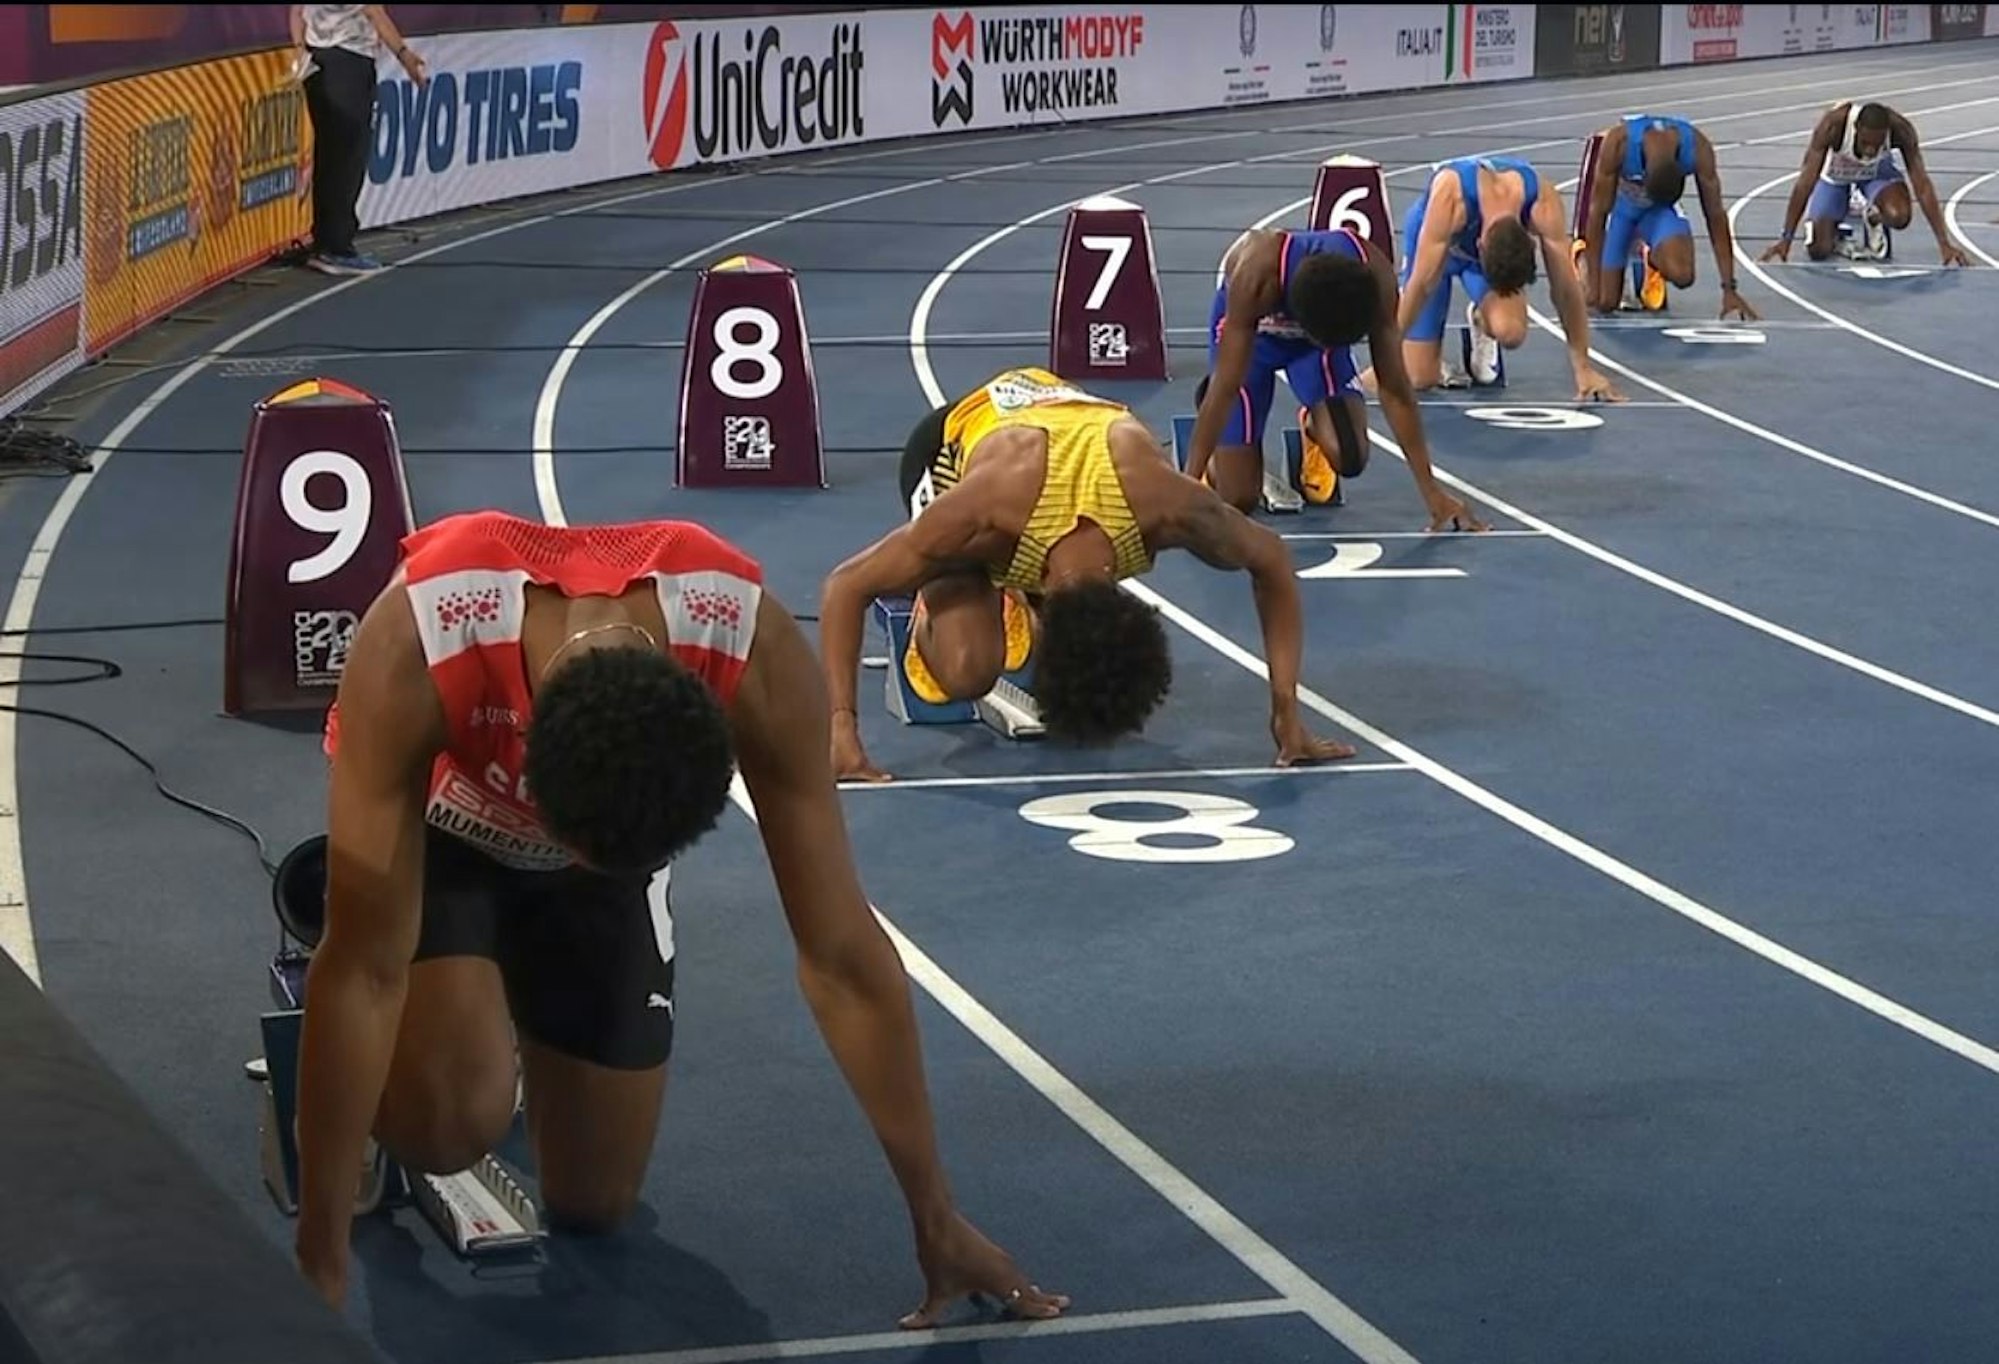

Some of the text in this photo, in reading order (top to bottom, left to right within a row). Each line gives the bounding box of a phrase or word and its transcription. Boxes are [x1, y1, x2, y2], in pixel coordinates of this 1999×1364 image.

[368, 72, 458, 184] OYO
[464, 61, 581, 165] TIRES
[694, 22, 863, 158] UniCredit
[1002, 67, 1119, 112] WORKWEAR
[1329, 187, 1371, 240] 6
[1081, 236, 1132, 310] 7
[710, 307, 783, 398] 8
[280, 450, 371, 583] 9
[295, 611, 314, 671] roma
[1018, 790, 1296, 863] 8
